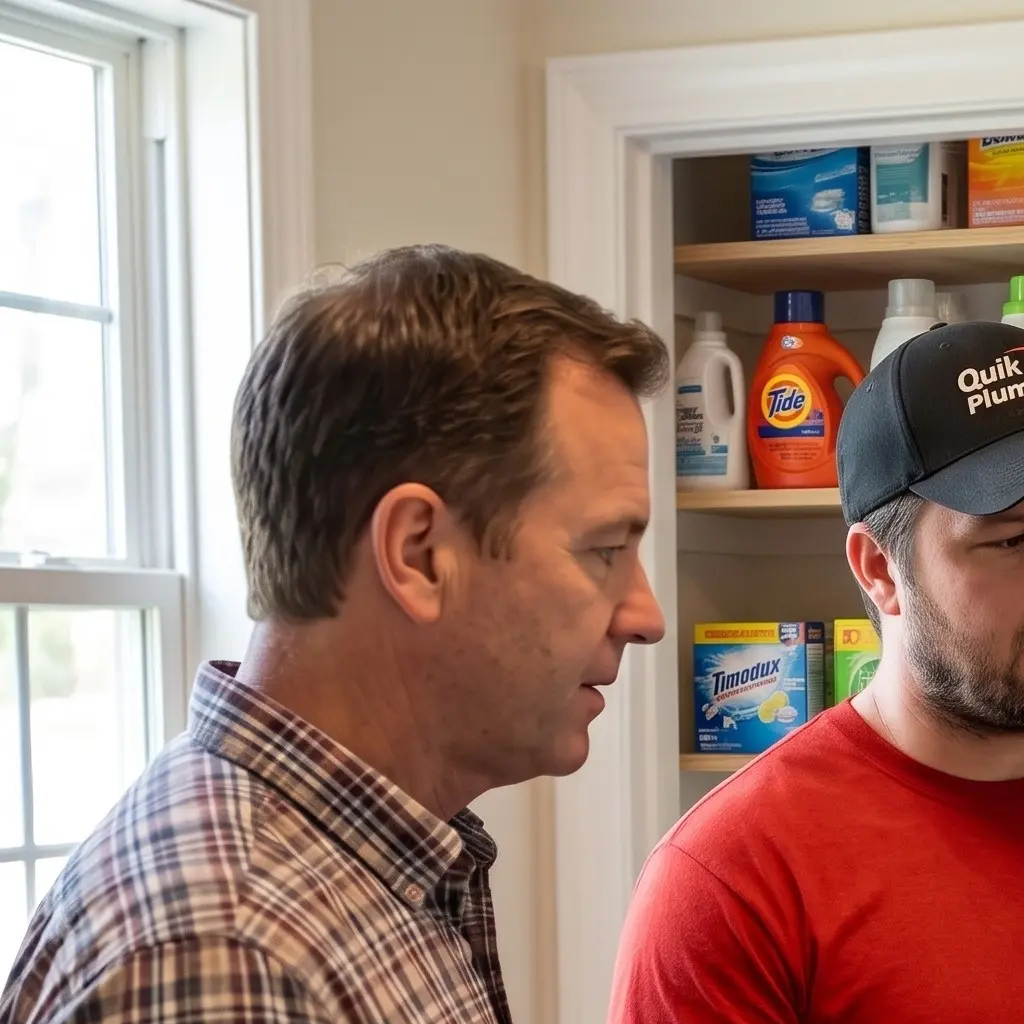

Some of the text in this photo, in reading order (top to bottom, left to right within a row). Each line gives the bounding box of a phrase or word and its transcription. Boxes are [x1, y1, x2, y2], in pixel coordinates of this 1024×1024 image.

[957, 355, 1024, 393] Quik
[767, 386, 806, 418] Tide
[712, 657, 782, 696] Timodux
